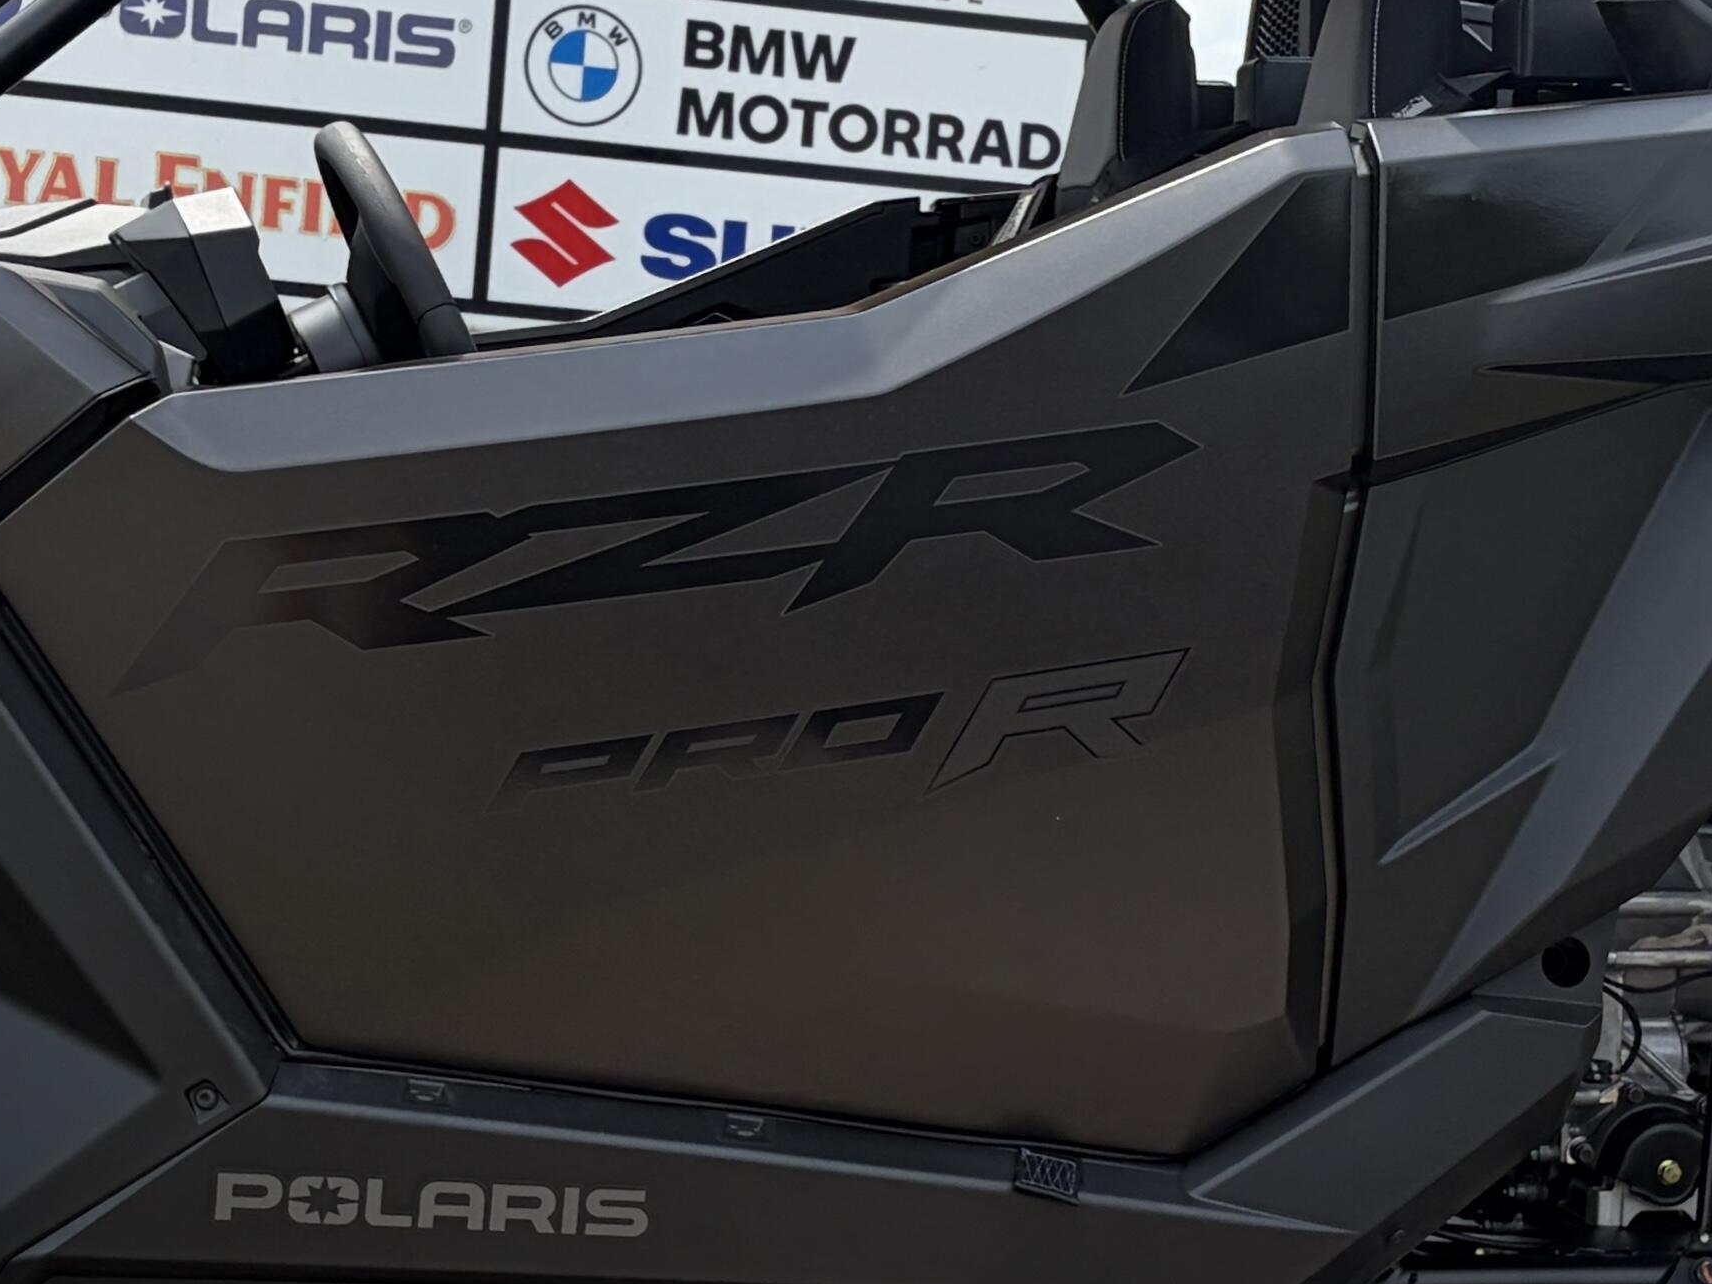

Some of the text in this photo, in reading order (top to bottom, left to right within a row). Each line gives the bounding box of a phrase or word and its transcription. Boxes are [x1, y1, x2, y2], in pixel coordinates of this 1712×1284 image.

[543, 11, 630, 49] BMW
[683, 18, 857, 84] BMW
[676, 87, 1062, 171] MOTORRAD
[156, 150, 458, 252] ENFID
[105, 420, 1203, 699] RZR
[214, 1172, 649, 1238] POLARIS
